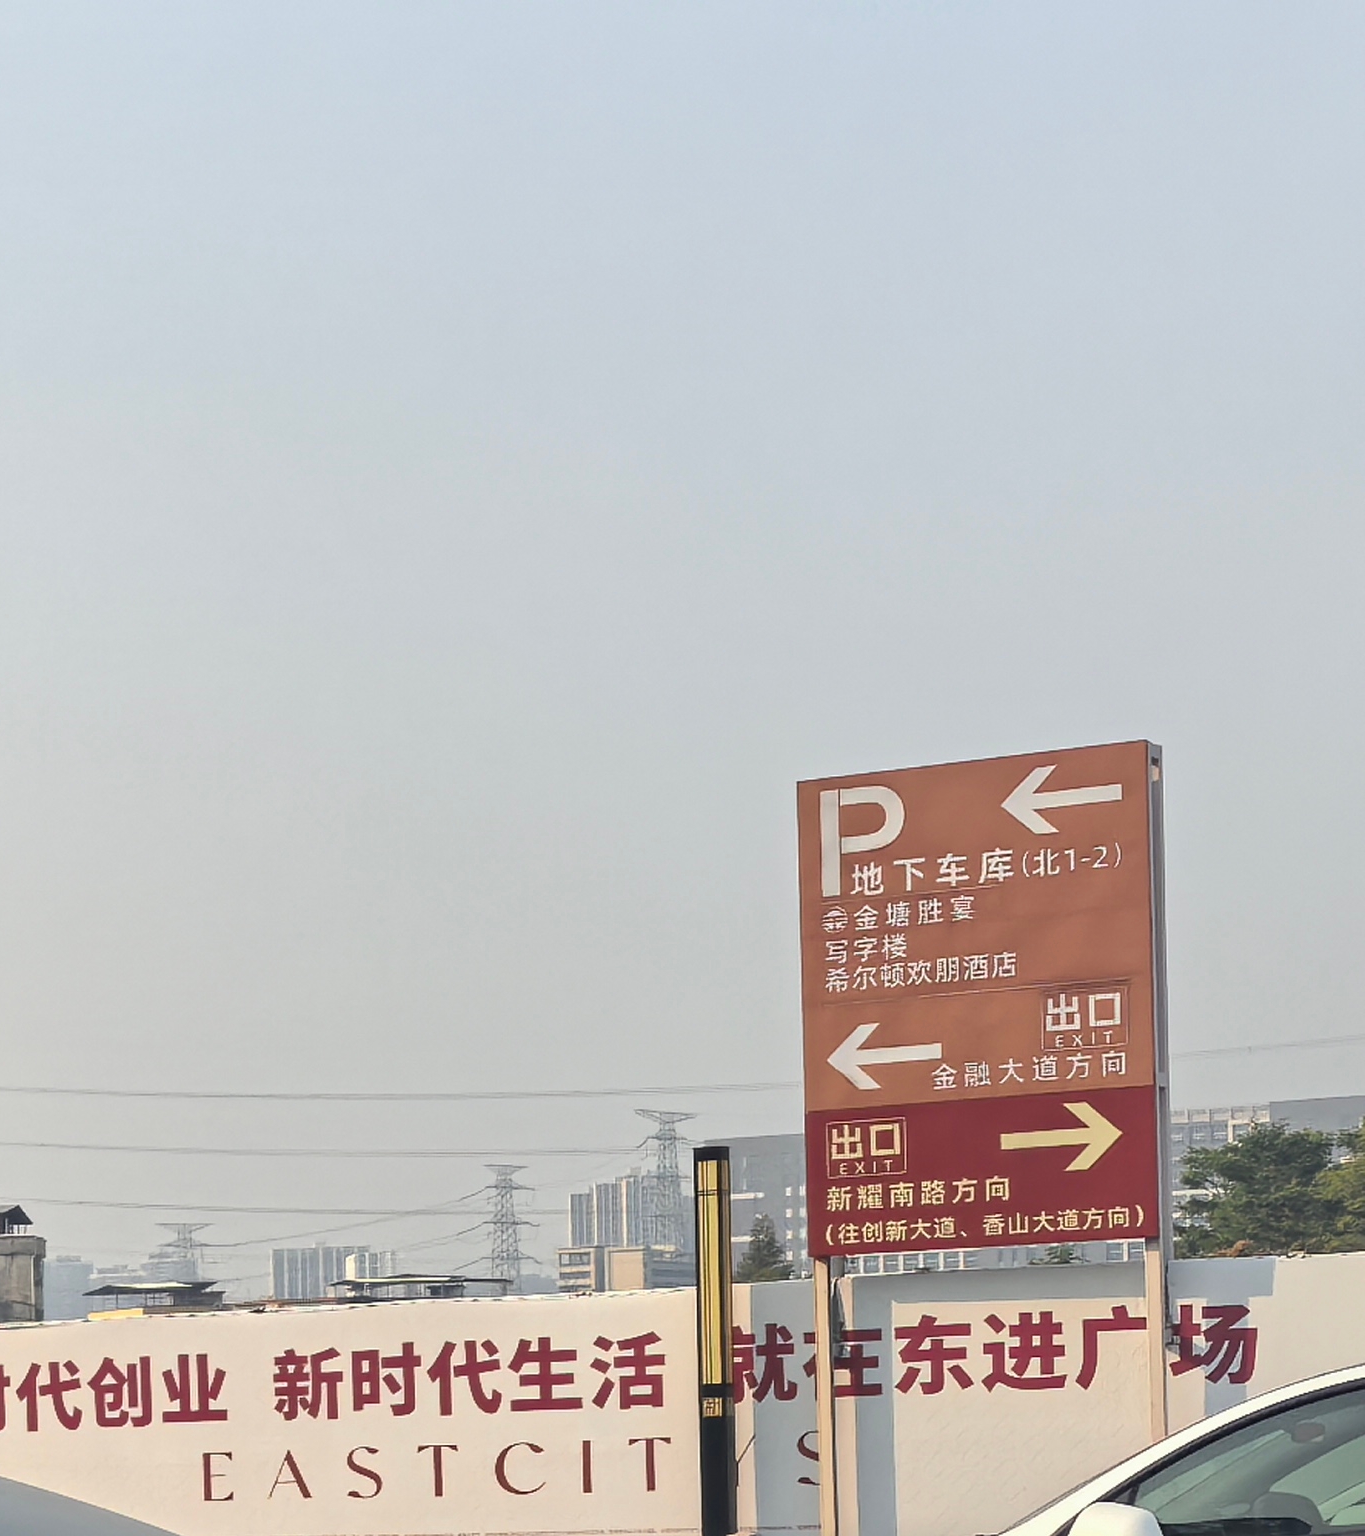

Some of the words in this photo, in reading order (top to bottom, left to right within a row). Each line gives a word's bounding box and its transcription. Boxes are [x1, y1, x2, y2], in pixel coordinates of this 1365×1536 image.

[853, 895, 976, 932] 金塘胜宴
[825, 933, 908, 964] 写字楼
[825, 951, 1018, 993] 希尔顿欢朋酒店
[1046, 992, 1121, 1032] 出口
[1055, 1030, 1113, 1047] EXIT
[931, 1050, 1127, 1090] 金融大道方向
[831, 1123, 901, 1160] 出口
[839, 1160, 893, 1175] EXIT
[826, 1176, 1011, 1212] 新耀南路方向
[273, 1329, 666, 1422] 新时代生活
